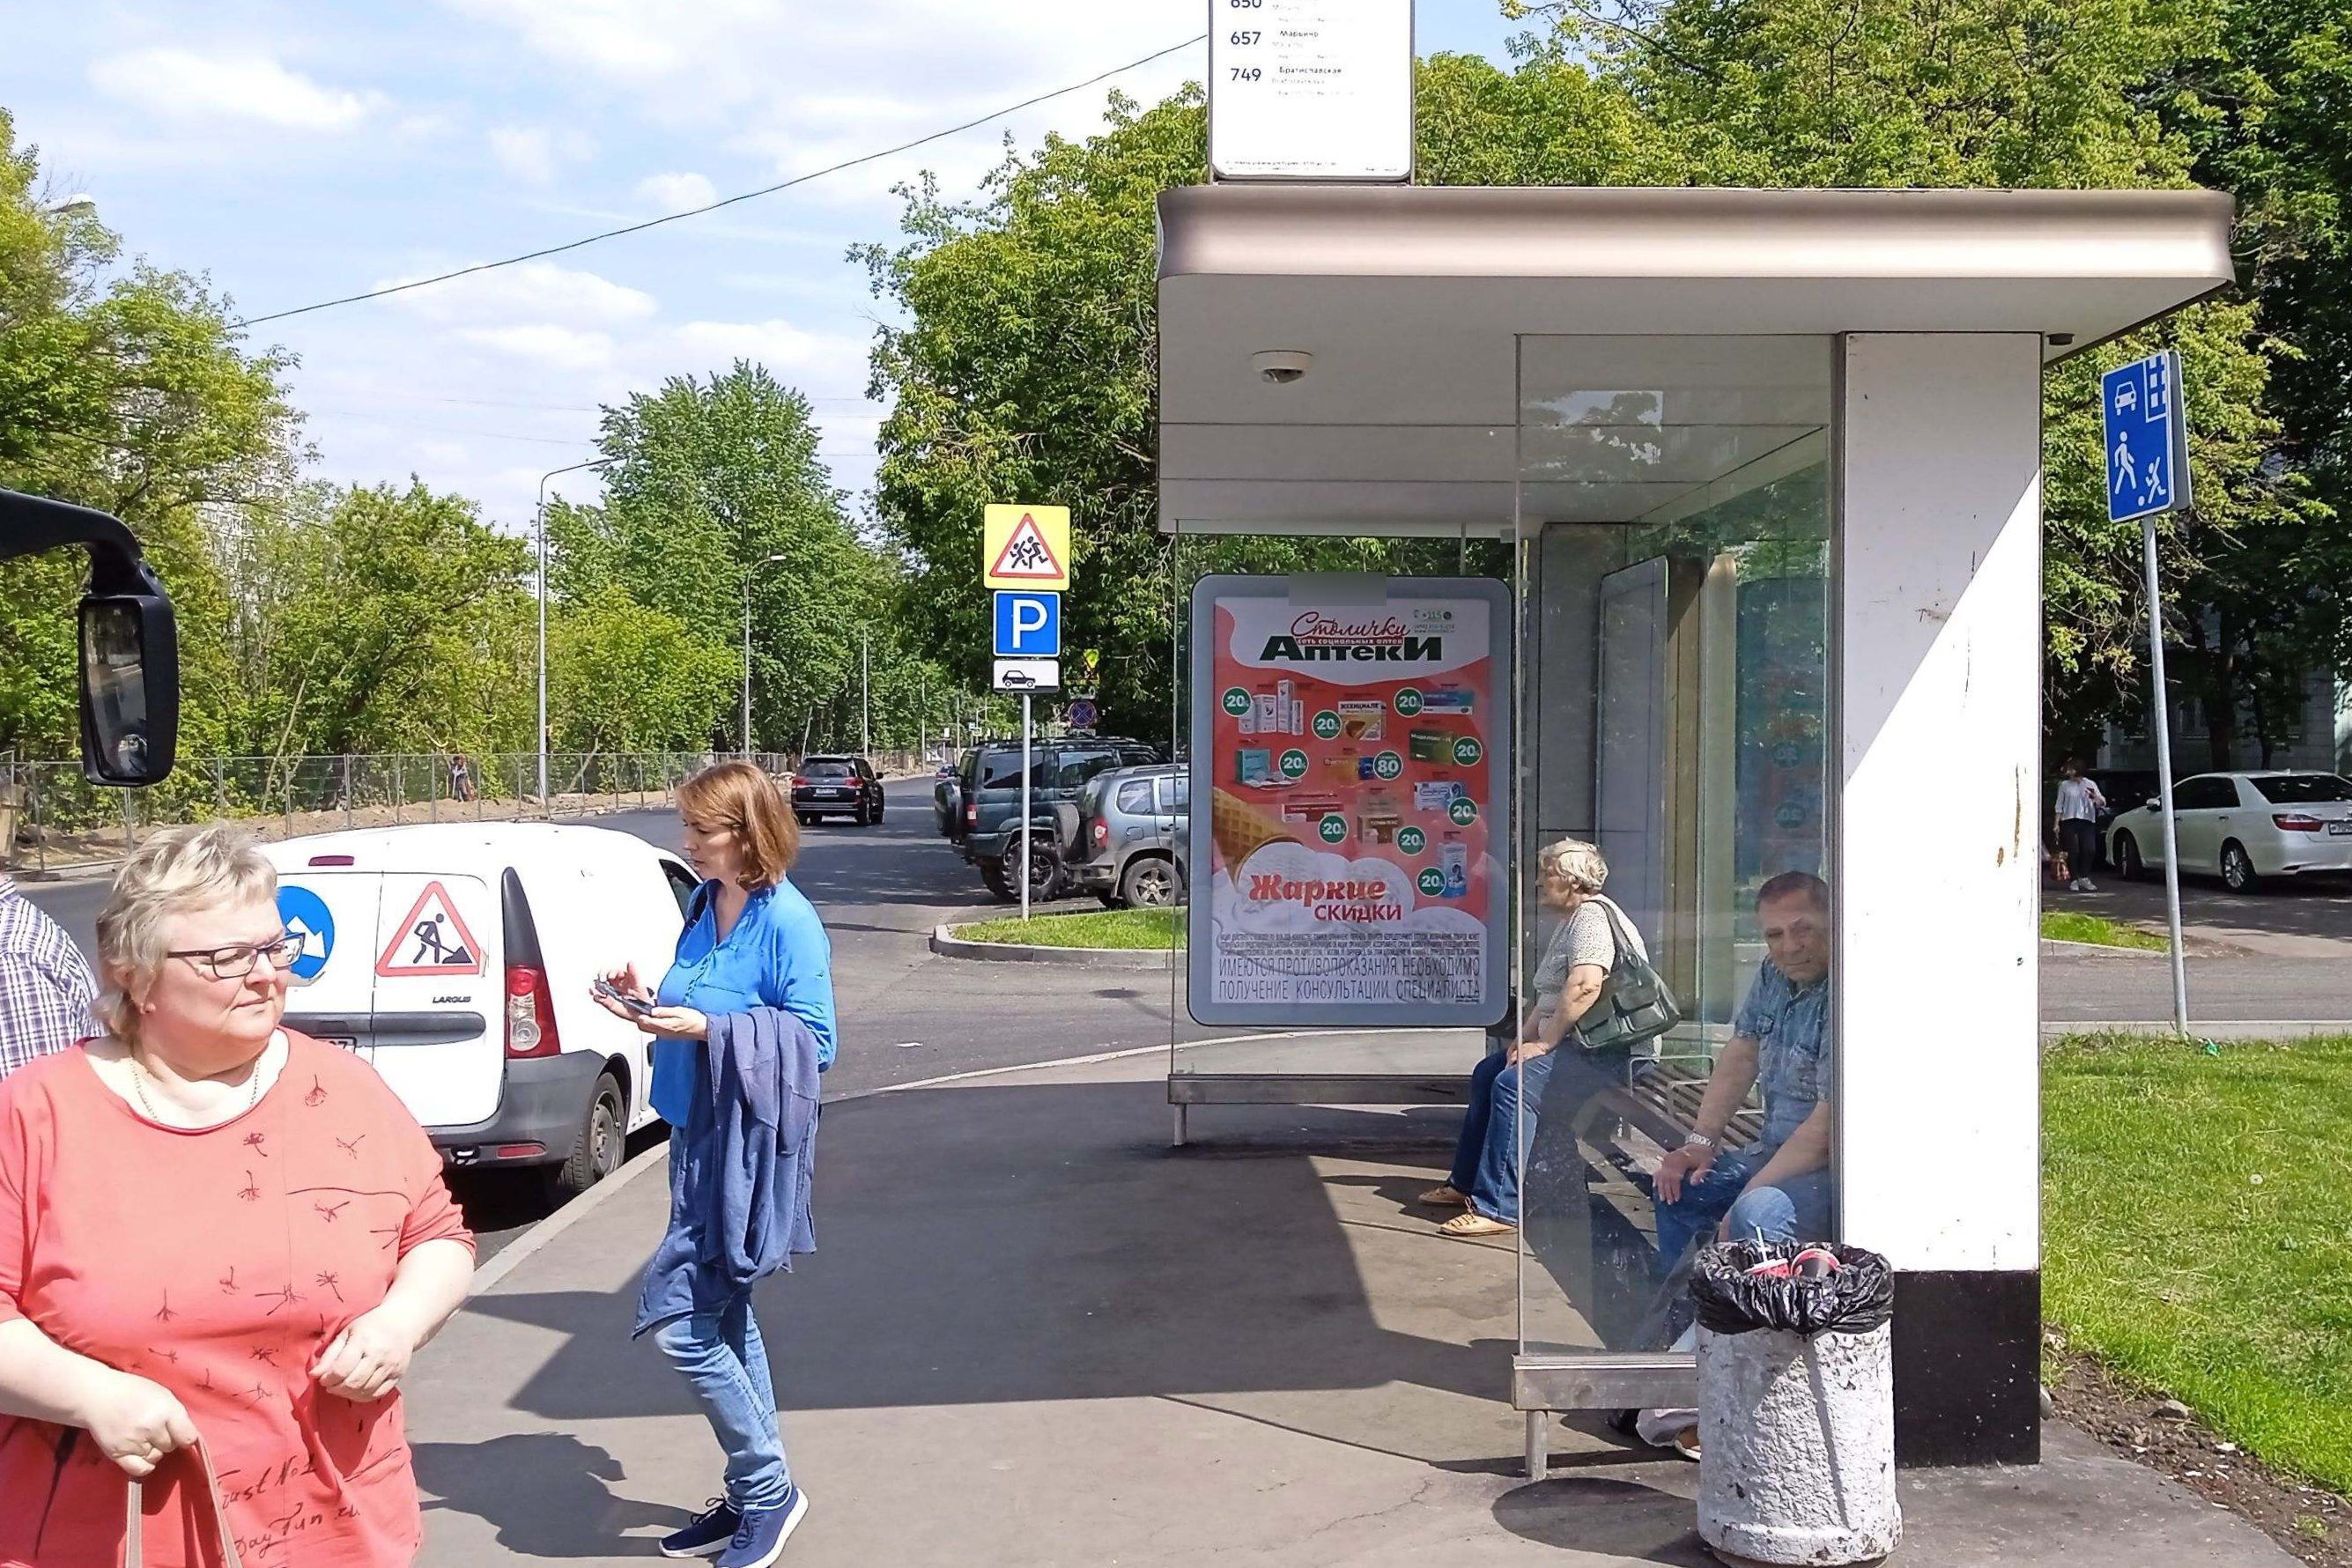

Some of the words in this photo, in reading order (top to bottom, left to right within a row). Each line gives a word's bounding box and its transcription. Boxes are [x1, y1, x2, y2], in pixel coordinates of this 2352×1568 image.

[1230, 31, 1261, 45] 657
[1230, 68, 1261, 82] 749
[1012, 599, 1048, 649] P
[1291, 611, 1411, 637] Столички
[1377, 759, 1400, 773] 80
[1248, 874, 1387, 907] Жаркие
[1219, 957, 1275, 977] ИМЕЮТСЯ
[1402, 957, 1480, 978] НЕОБХОДИМО
[432, 995, 472, 1004] LARGUS
[1219, 980, 1289, 1000] ПОЛУЧЕНИЕ
[1296, 980, 1389, 1001] КОНСУЛЬТАЦИИ
[1395, 980, 1480, 1000] СПЕЦИАЛИСТА
